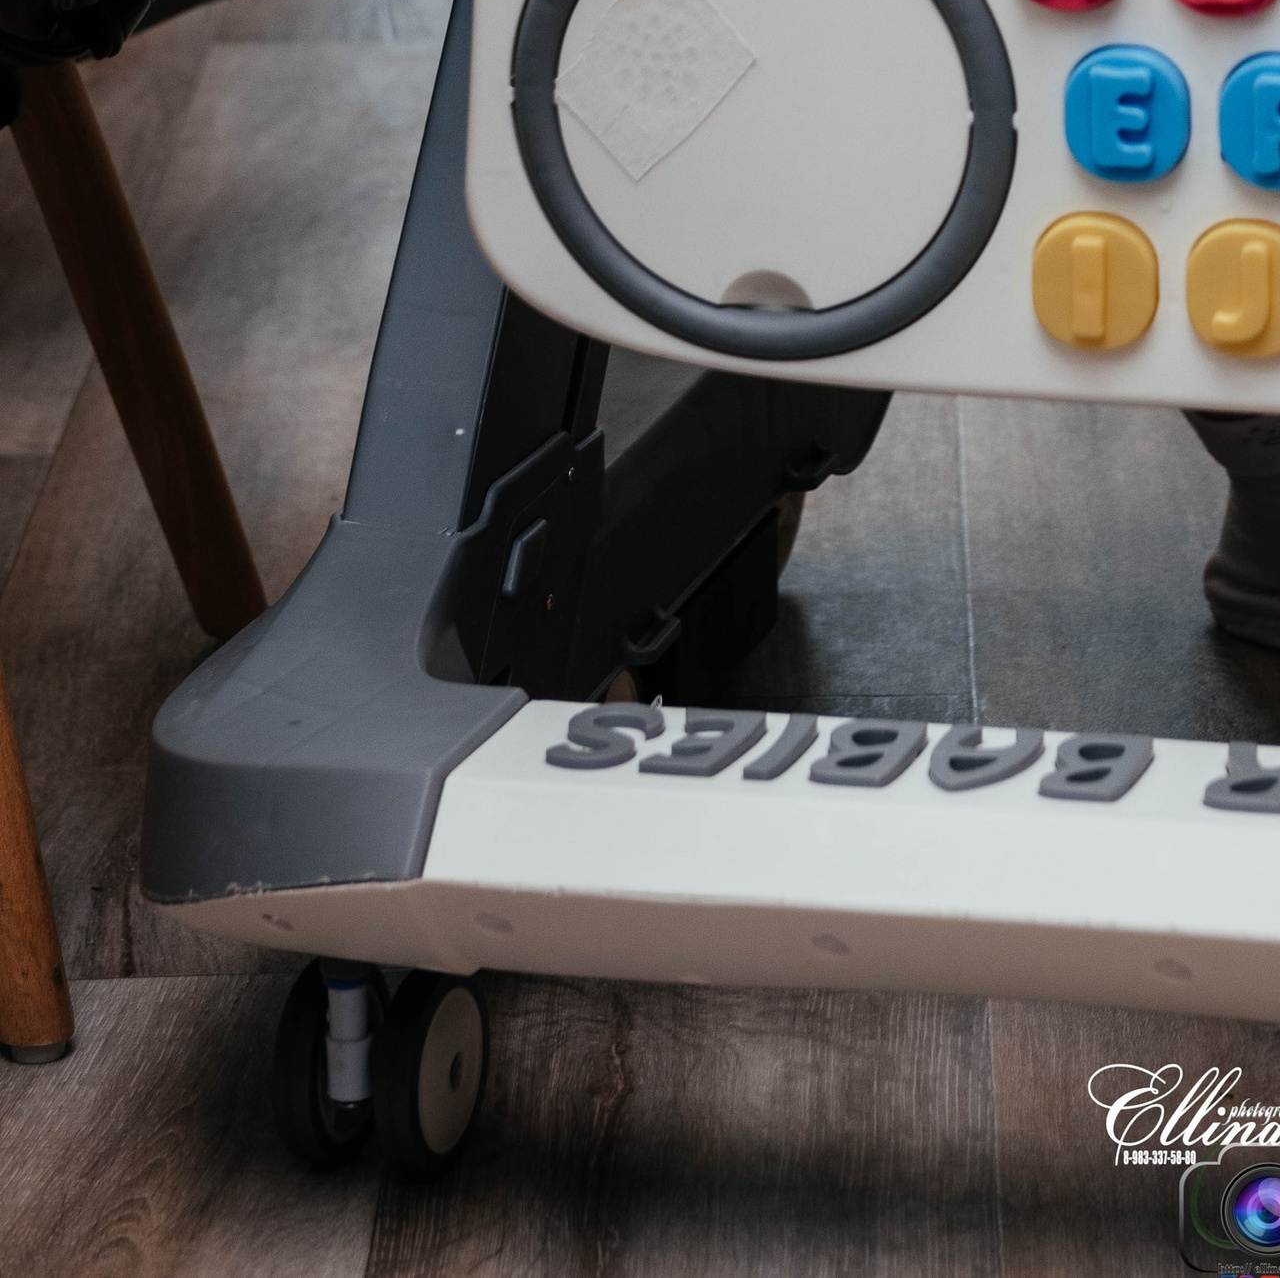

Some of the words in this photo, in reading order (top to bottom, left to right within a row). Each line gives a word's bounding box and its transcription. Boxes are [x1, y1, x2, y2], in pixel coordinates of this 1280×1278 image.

[1088, 65, 1154, 169] E
[1212, 240, 1272, 344] J
[546, 701, 1155, 803] BABIES
